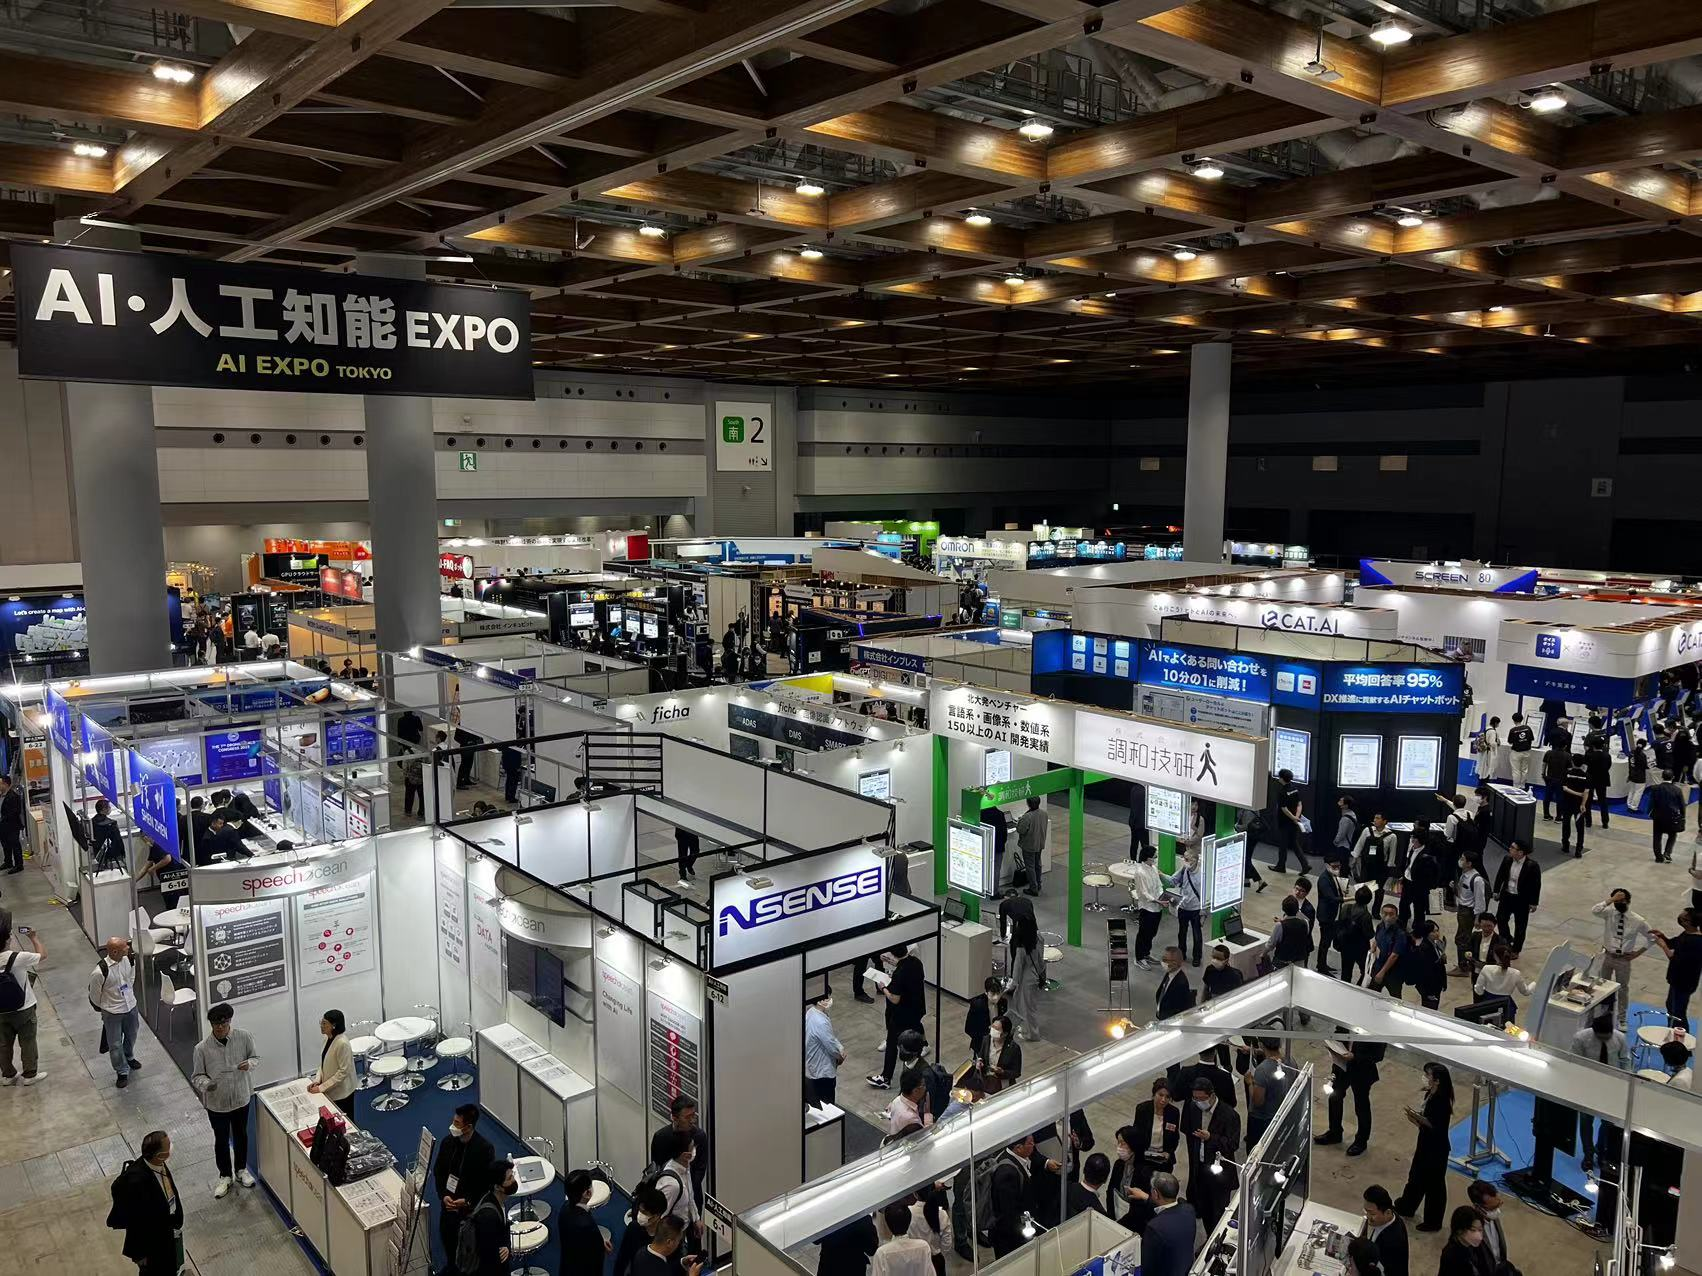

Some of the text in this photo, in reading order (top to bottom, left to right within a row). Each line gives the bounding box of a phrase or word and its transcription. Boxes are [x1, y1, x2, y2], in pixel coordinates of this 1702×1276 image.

[405, 310, 520, 354] EXPO
[216, 353, 392, 380] AI EXPO TOKYO
[728, 426, 739, 441] 南
[750, 417, 764, 443] 2
[941, 541, 975, 553] OMRON
[1415, 571, 1469, 583] SCREEN
[1281, 613, 1340, 634] CAT.AI
[1149, 649, 1268, 677] AIでよくある問い合わせを
[778, 701, 797, 715] ficha
[967, 693, 1028, 713] 北大発ベンチャー
[651, 704, 690, 725] ficha
[788, 729, 802, 741] DMS
[1106, 737, 1195, 779] 調和技研
[168, 880, 187, 889] 6-16
[711, 990, 724, 1003] 6-12
[713, 1218, 725, 1236] 6-1
